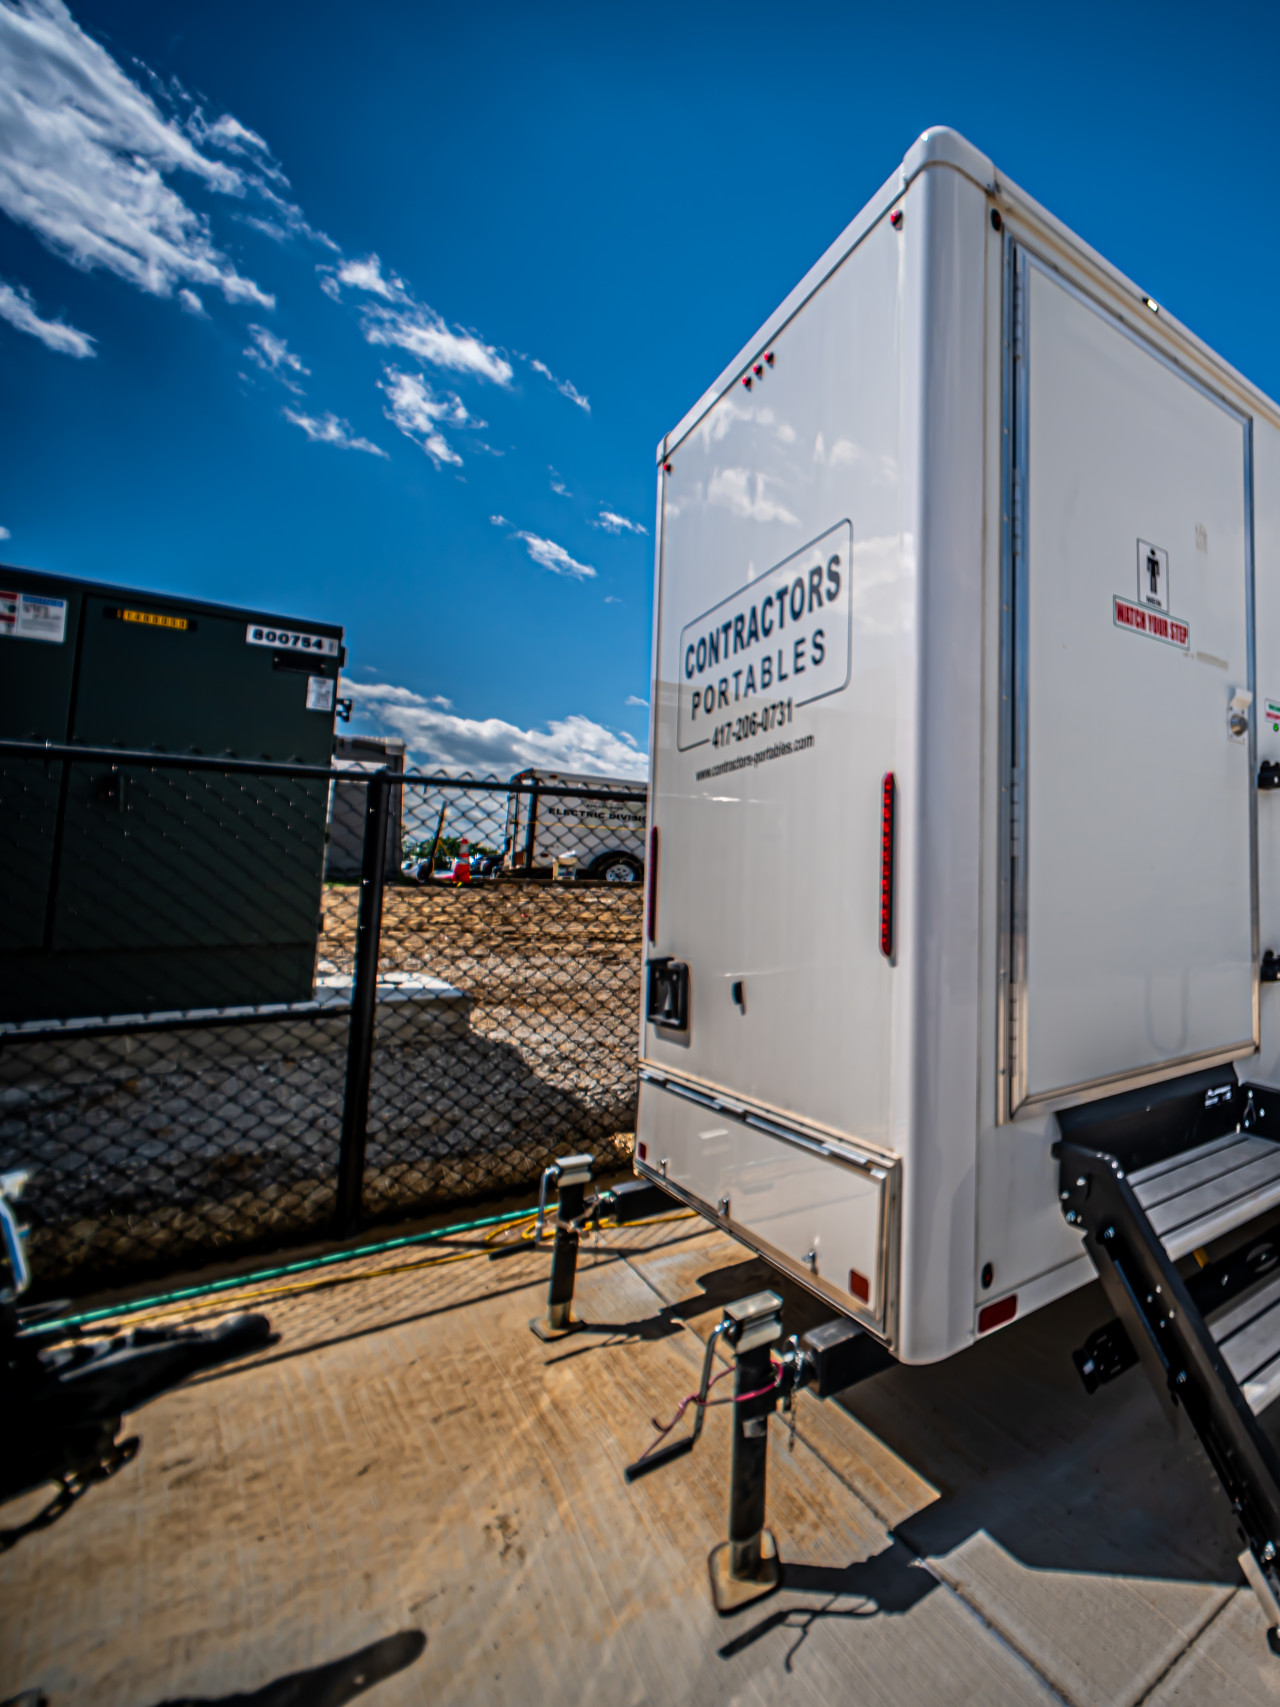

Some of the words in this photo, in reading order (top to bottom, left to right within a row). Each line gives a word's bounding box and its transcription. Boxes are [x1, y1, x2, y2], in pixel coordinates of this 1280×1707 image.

[684, 554, 841, 679] CONTRACTORS
[1116, 601, 1146, 630] WATCH
[1148, 614, 1168, 638] YOUR
[1170, 622, 1188, 644] STEP
[691, 628, 825, 720] PORTABLES
[711, 697, 794, 748] 417-206-0731
[695, 733, 815, 781] www.contractors-portables.com
